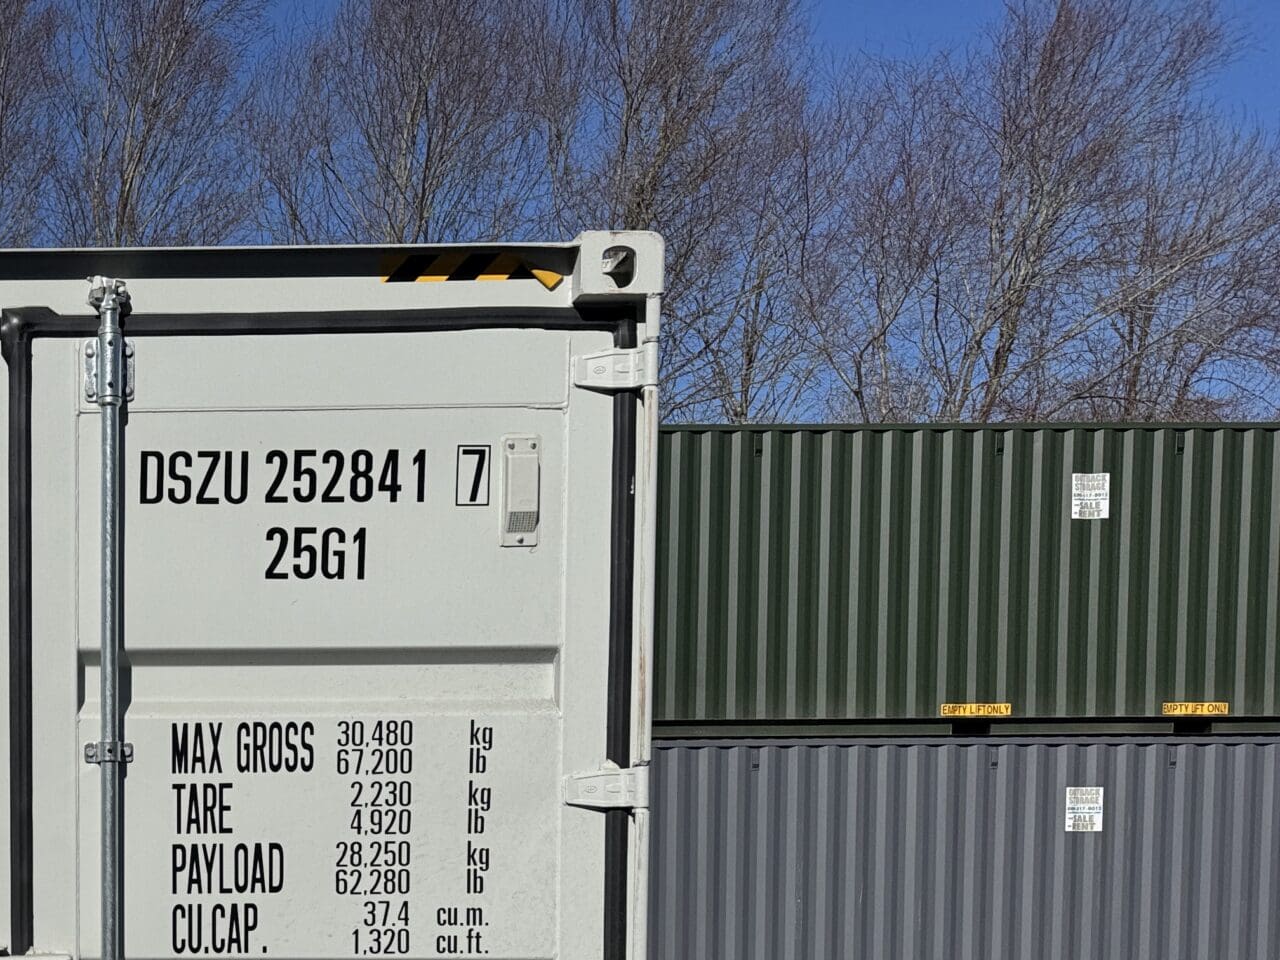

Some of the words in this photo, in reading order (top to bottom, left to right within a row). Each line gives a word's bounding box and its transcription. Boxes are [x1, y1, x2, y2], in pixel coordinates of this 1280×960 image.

[139, 450, 249, 504] DSZU
[264, 449, 427, 503] 252841
[461, 447, 487, 503] 7
[264, 527, 367, 580] 25G1
[942, 705, 968, 714] EMPTY
[987, 705, 1010, 714] ONLY
[171, 722, 223, 774] MAX
[236, 721, 315, 773] GROSS
[337, 720, 413, 747] 30,480
[470, 719, 494, 751] kg
[337, 748, 413, 775] 67,200
[469, 748, 487, 774] lb
[171, 782, 233, 834] TARE
[350, 780, 412, 808] 2,230
[468, 780, 492, 811] kg
[350, 809, 412, 836] 4,920
[467, 808, 485, 834] lb
[171, 843, 284, 895] PAYLOAD
[335, 841, 411, 868] 28,250
[466, 840, 490, 872] kg
[335, 868, 411, 896] 62,280
[466, 868, 484, 894] lb
[363, 901, 410, 927] 37.4
[436, 906, 489, 927] cu.m.
[351, 928, 410, 955] 1,320
[436, 928, 489, 954] cu.ft.
